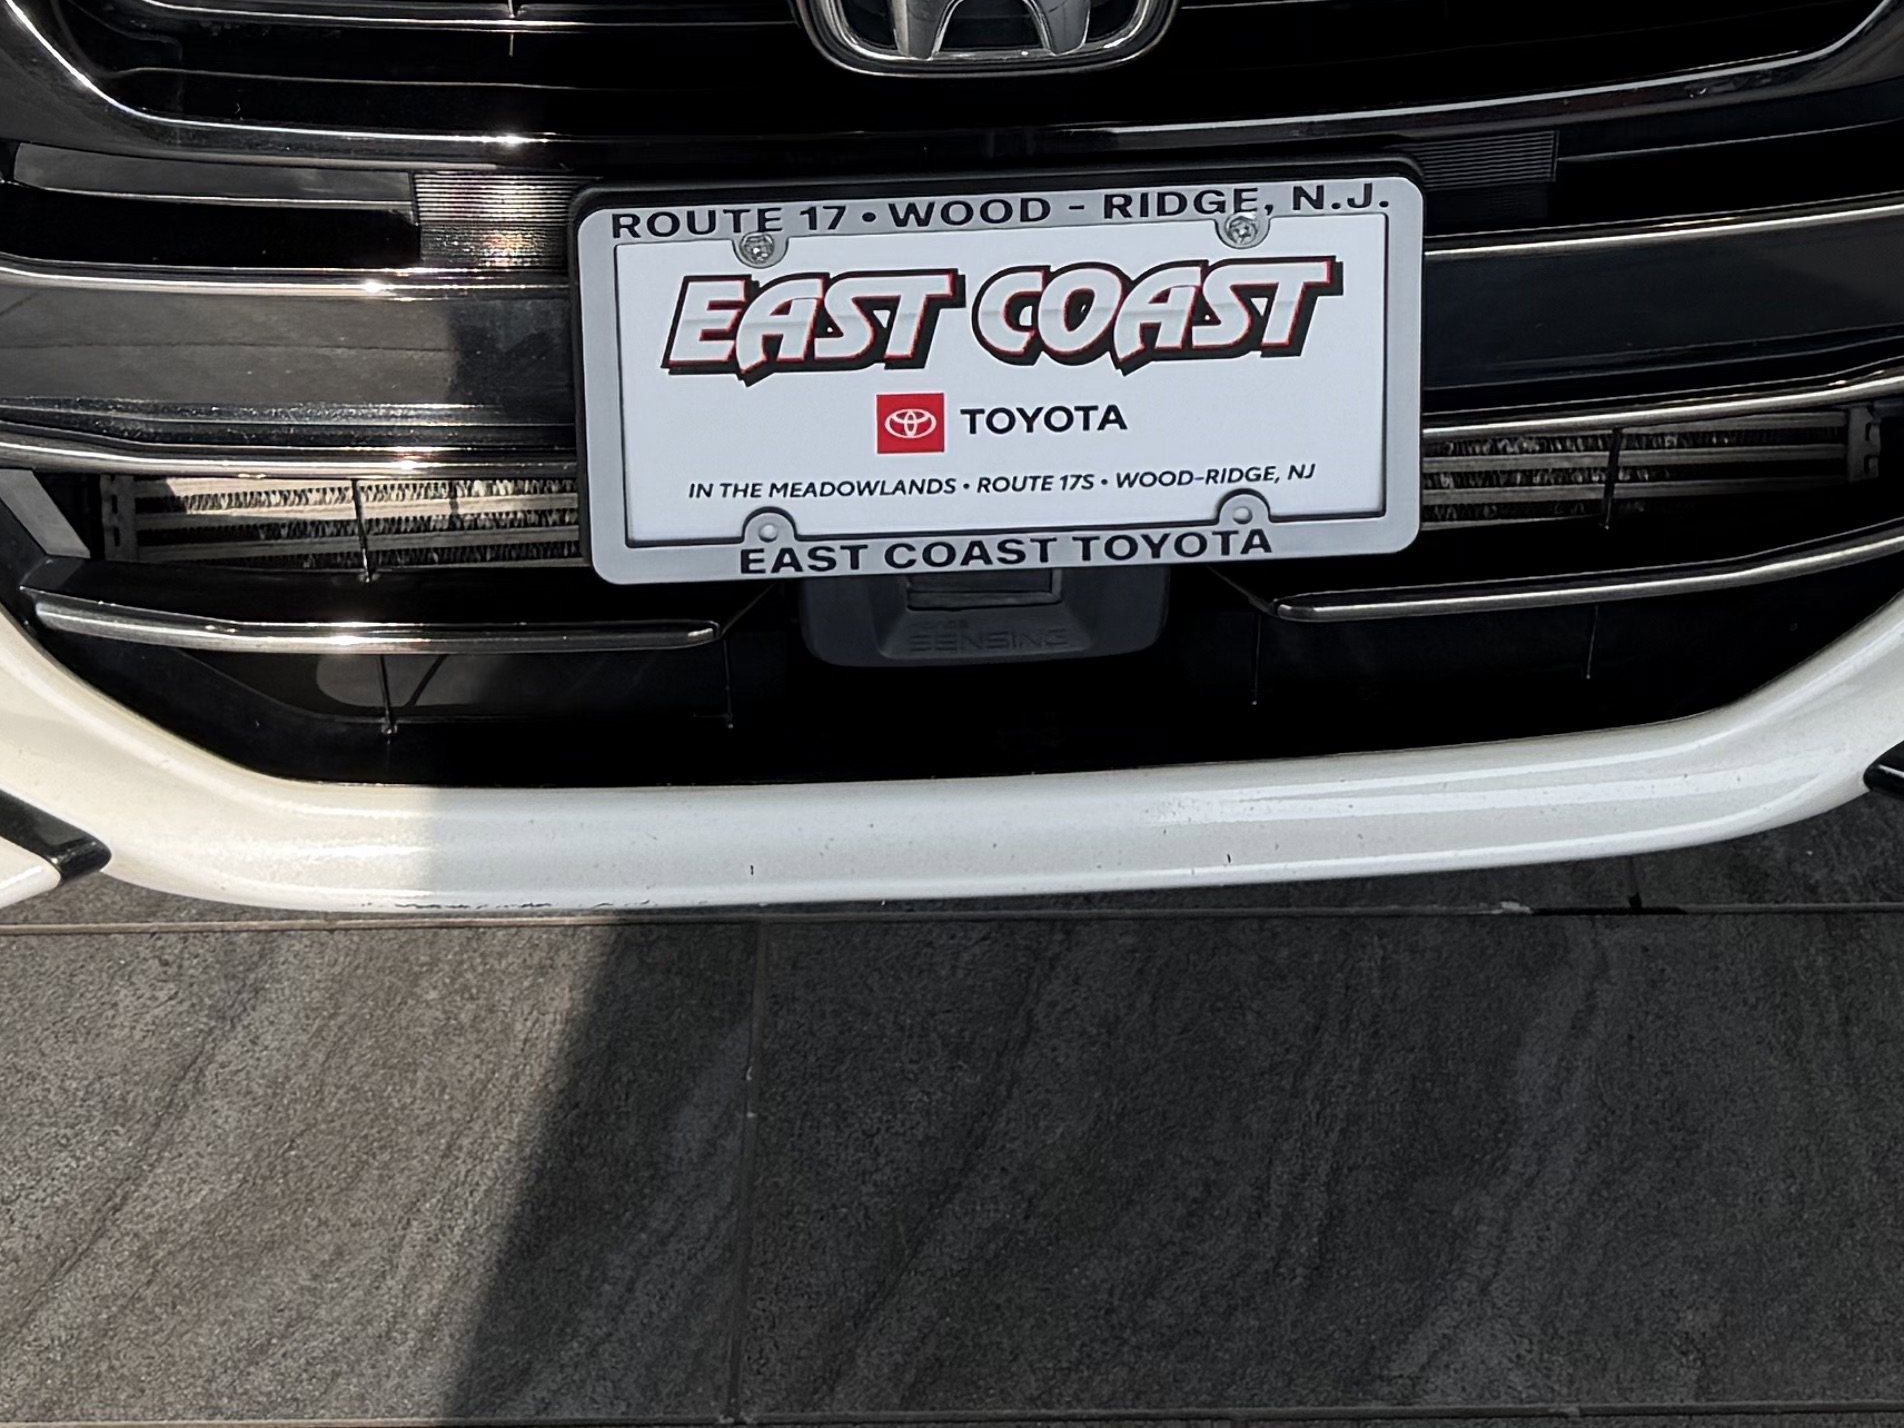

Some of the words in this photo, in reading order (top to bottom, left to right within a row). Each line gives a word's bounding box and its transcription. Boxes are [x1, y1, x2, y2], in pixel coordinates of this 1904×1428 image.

[612, 207, 783, 239] ROUTE
[799, 205, 847, 231] 17
[888, 198, 1051, 228] WOOD
[1103, 187, 1273, 220] RIDGE,
[1292, 183, 1390, 211] N.J.
[661, 267, 966, 387] EAST
[970, 255, 1343, 377] COAST
[960, 404, 1128, 435] TOYOTA
[688, 482, 713, 498] IN
[719, 482, 762, 498] THE
[769, 477, 957, 498] MEADOWLANDS
[977, 474, 1053, 493] ROUTE
[1059, 473, 1094, 491] 17S
[1116, 465, 1281, 488] WOOD-RIDGE,
[1287, 463, 1316, 480] NJ
[740, 544, 868, 574] EAST
[884, 536, 1057, 569] COAST
[1072, 528, 1272, 562] TOYOTA
